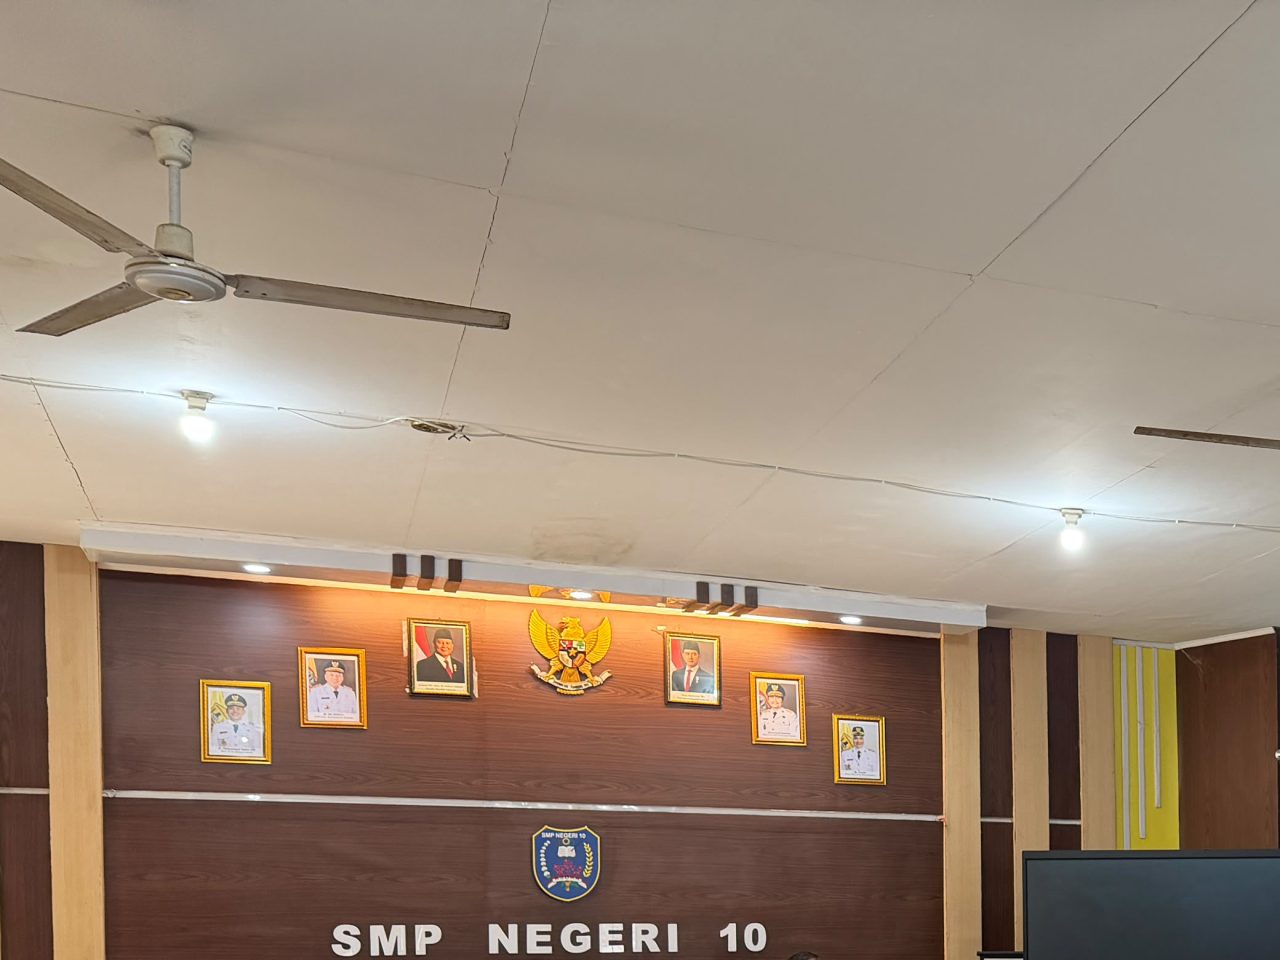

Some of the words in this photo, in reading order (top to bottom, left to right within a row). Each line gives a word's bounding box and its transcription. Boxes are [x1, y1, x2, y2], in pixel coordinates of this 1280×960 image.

[331, 924, 443, 957] SMP
[488, 922, 679, 954] NEGERI
[719, 922, 767, 952] 10
